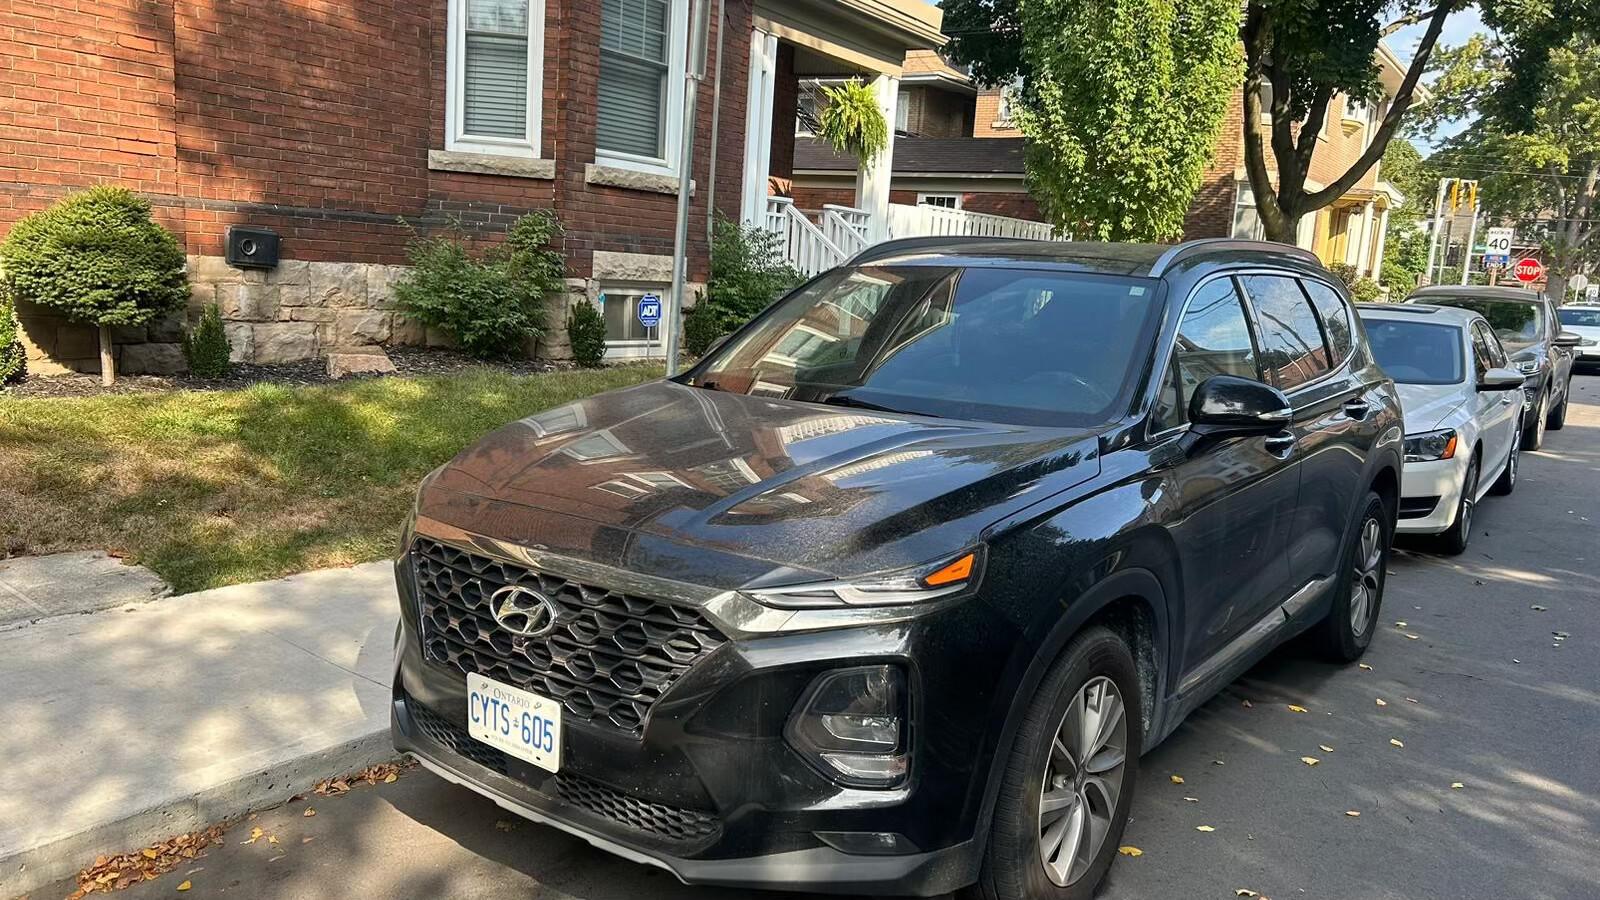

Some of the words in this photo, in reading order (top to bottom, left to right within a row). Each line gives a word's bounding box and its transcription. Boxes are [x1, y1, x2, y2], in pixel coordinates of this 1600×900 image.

[1489, 238, 1509, 250] 40
[1517, 265, 1540, 275] STOP
[641, 305, 658, 316] ADT
[470, 691, 510, 735] CYTS
[521, 711, 554, 753] 605
